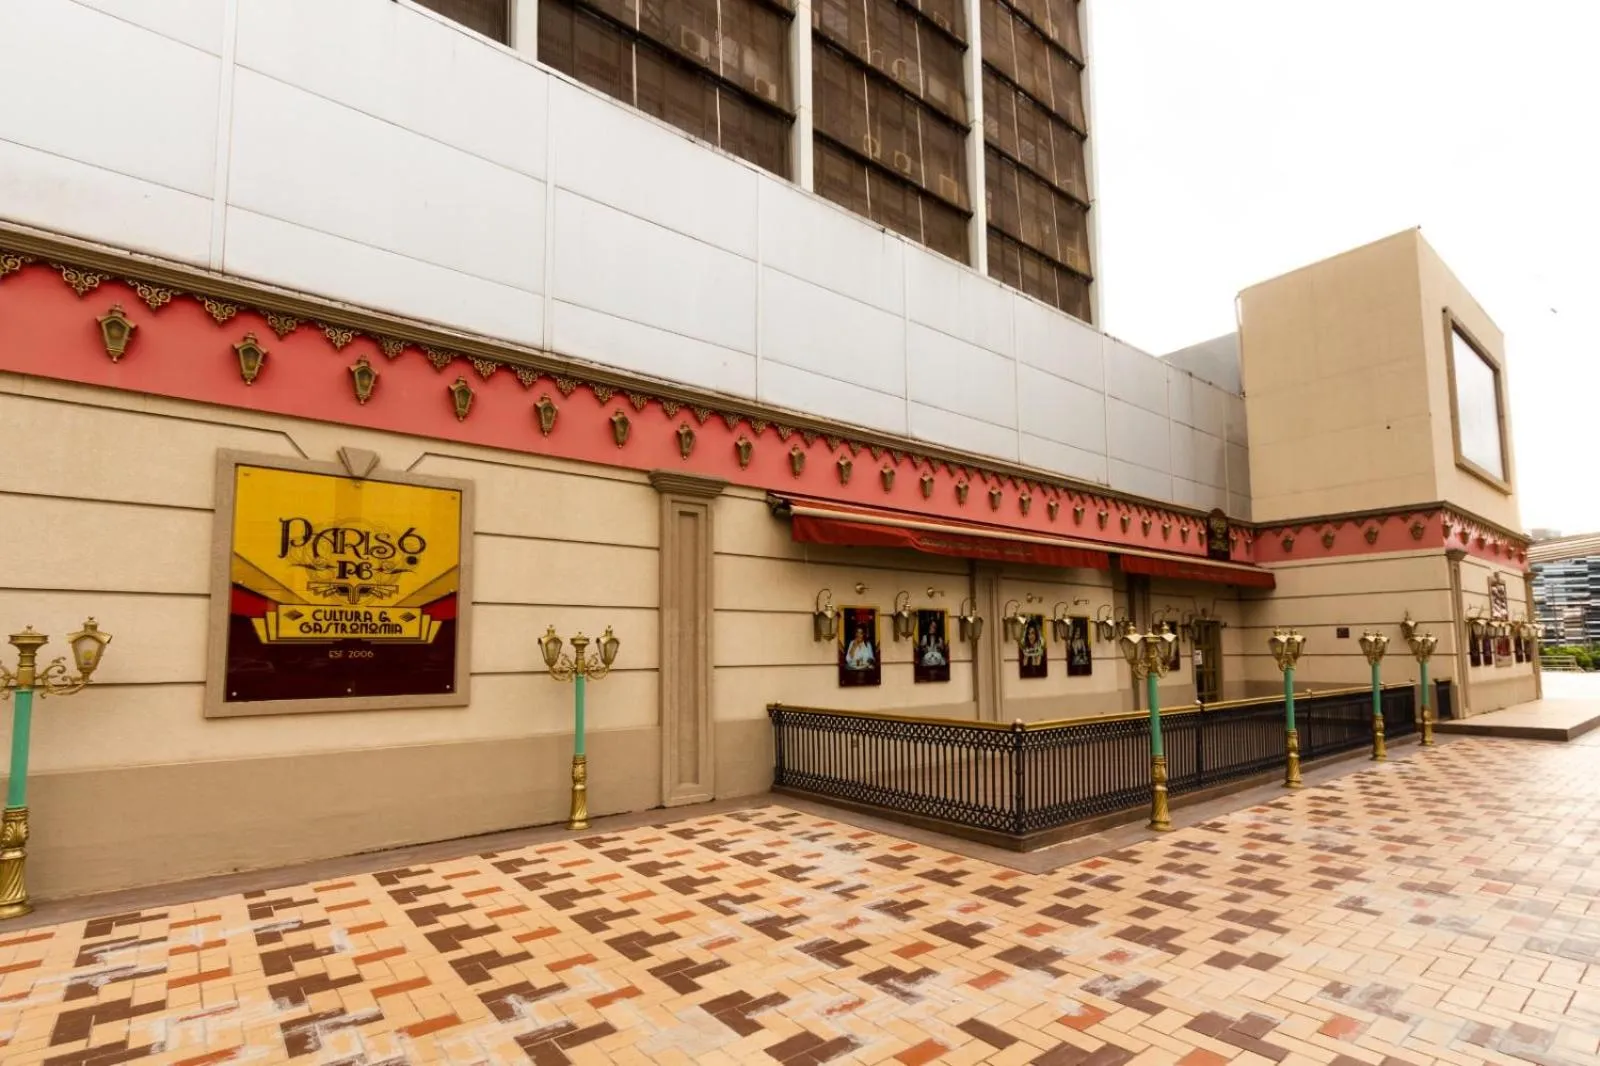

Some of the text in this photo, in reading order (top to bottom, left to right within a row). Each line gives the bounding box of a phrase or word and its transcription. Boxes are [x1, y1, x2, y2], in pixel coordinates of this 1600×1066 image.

[312, 609, 373, 622] CULTURA
[299, 622, 403, 635] GASTRONOMIA
[348, 650, 374, 659] 2006
